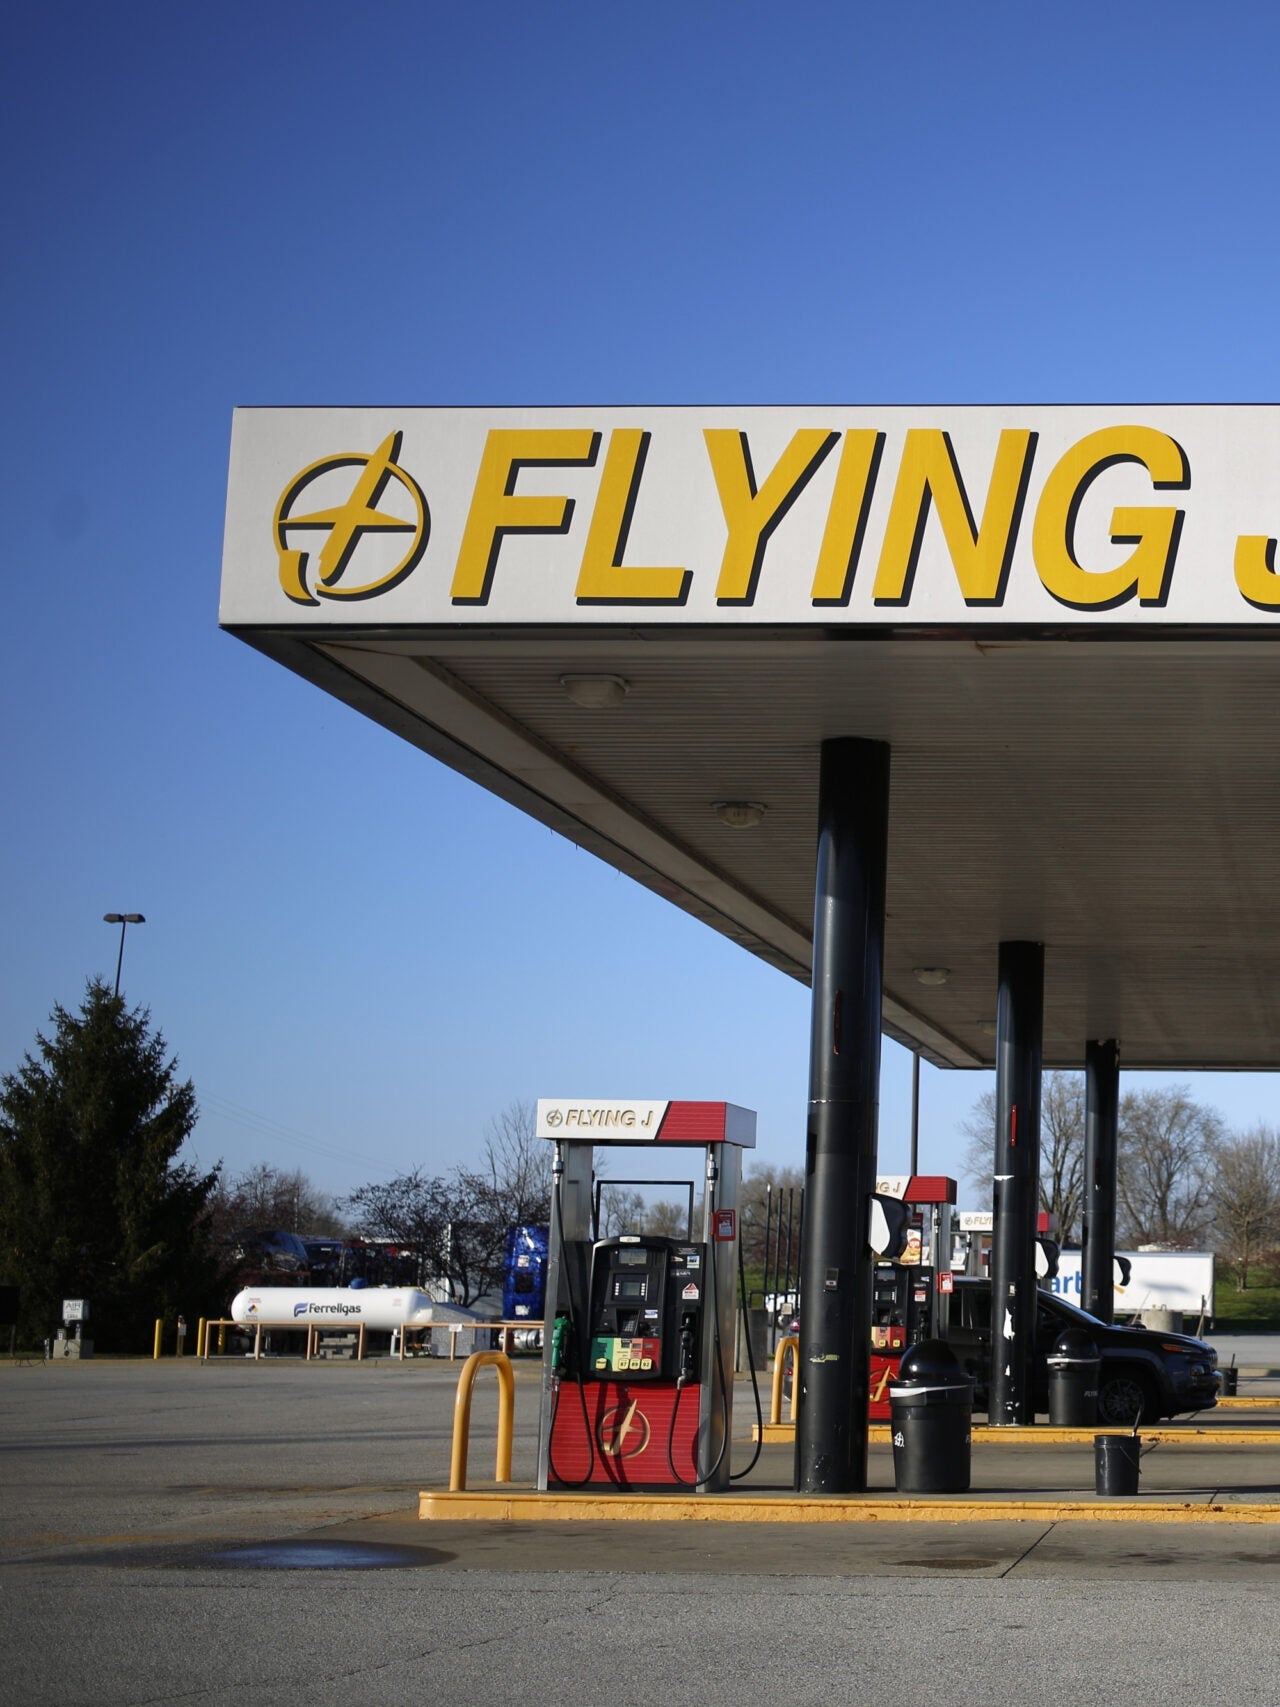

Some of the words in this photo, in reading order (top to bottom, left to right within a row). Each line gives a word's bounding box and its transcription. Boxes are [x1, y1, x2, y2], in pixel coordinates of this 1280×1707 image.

[450, 425, 1192, 610] FLYING
[565, 1108, 636, 1128] FLYING
[641, 1110, 654, 1128] J
[309, 1303, 361, 1316] Ferrellgas
